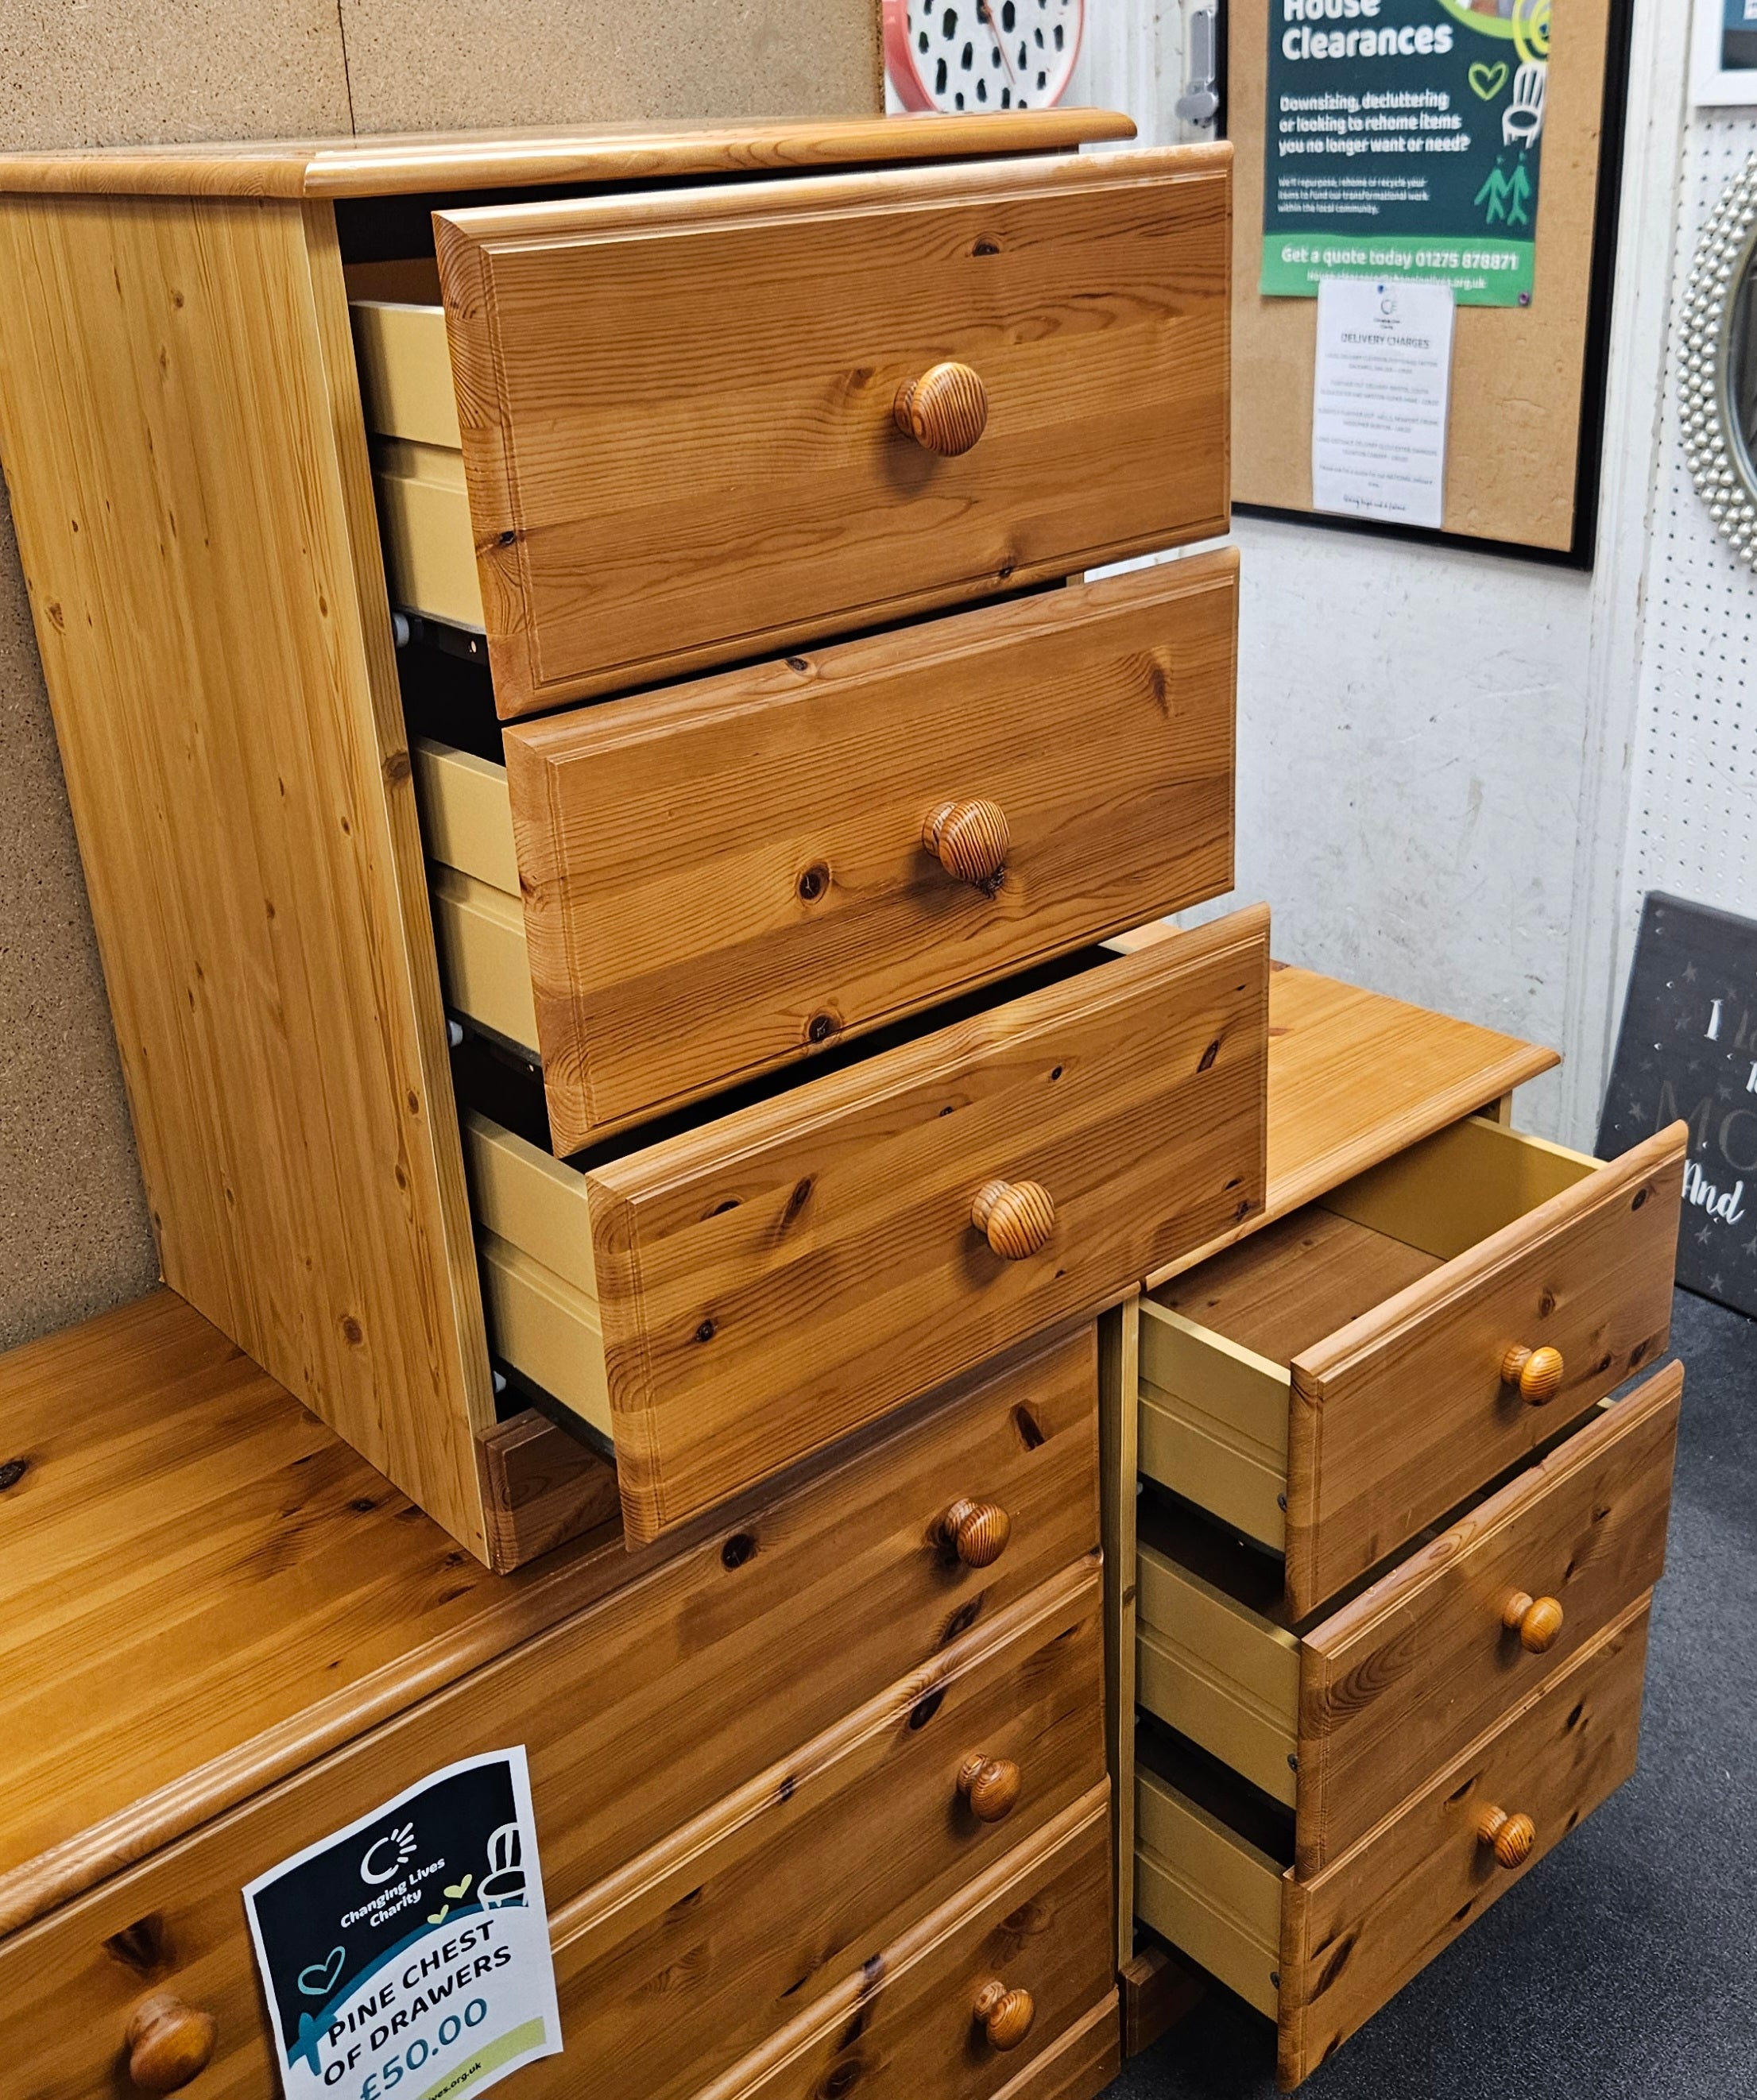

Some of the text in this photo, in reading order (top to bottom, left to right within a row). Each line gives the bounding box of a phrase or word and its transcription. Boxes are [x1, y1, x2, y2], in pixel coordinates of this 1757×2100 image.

[1284, 0, 1381, 21] House
[1282, 25, 1454, 60] Clearances
[1279, 89, 1450, 113] Downsizing, decluttering
[1279, 110, 1462, 134] or looking to rehome items
[1279, 133, 1472, 157] you no longer want or need?
[1281, 246, 1519, 270] Get a quote today 01275 878871
[1341, 333, 1430, 349] DELIVERY CHARGES
[340, 1858, 446, 1928] Changing Lives
[370, 1889, 422, 1927] Charity
[327, 1920, 494, 2048] PINE CHEST
[323, 1946, 513, 2086] OF DRAWERS
[359, 1998, 488, 2100] £50.00
[428, 2062, 482, 2100] ves.org.uk
